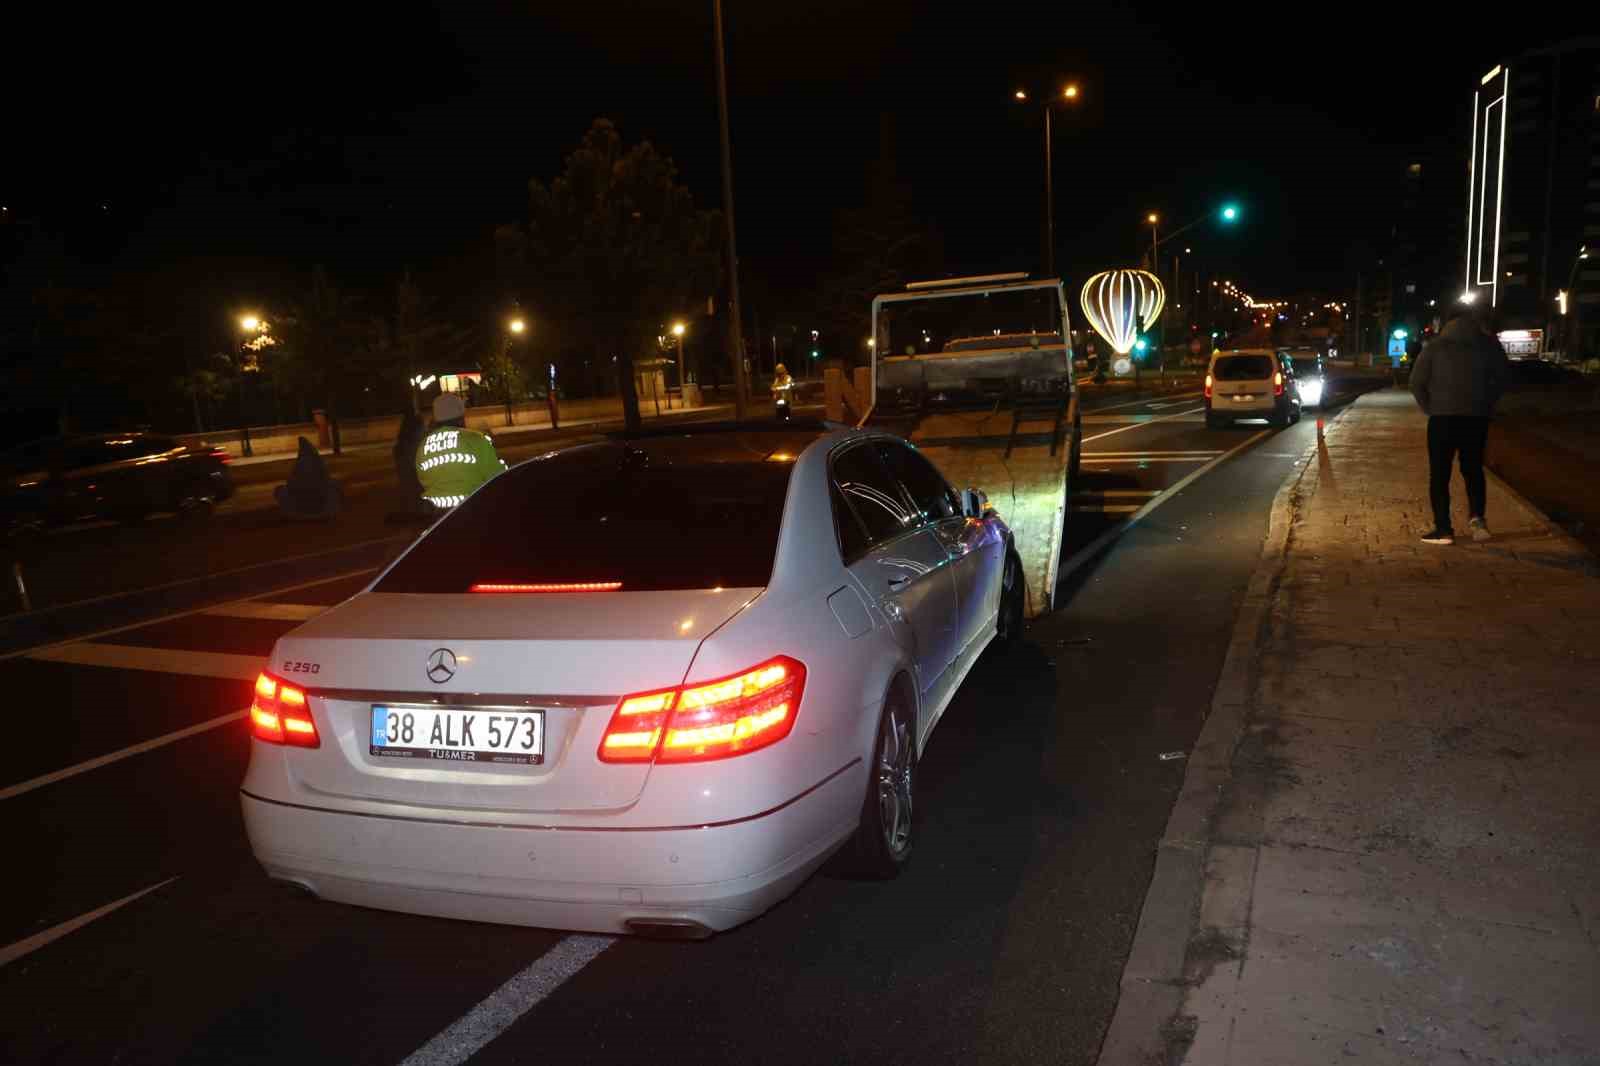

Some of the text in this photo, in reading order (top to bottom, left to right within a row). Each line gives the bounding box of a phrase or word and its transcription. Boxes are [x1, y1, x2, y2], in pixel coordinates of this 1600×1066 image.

[387, 712, 535, 749] 38 ALK 573
